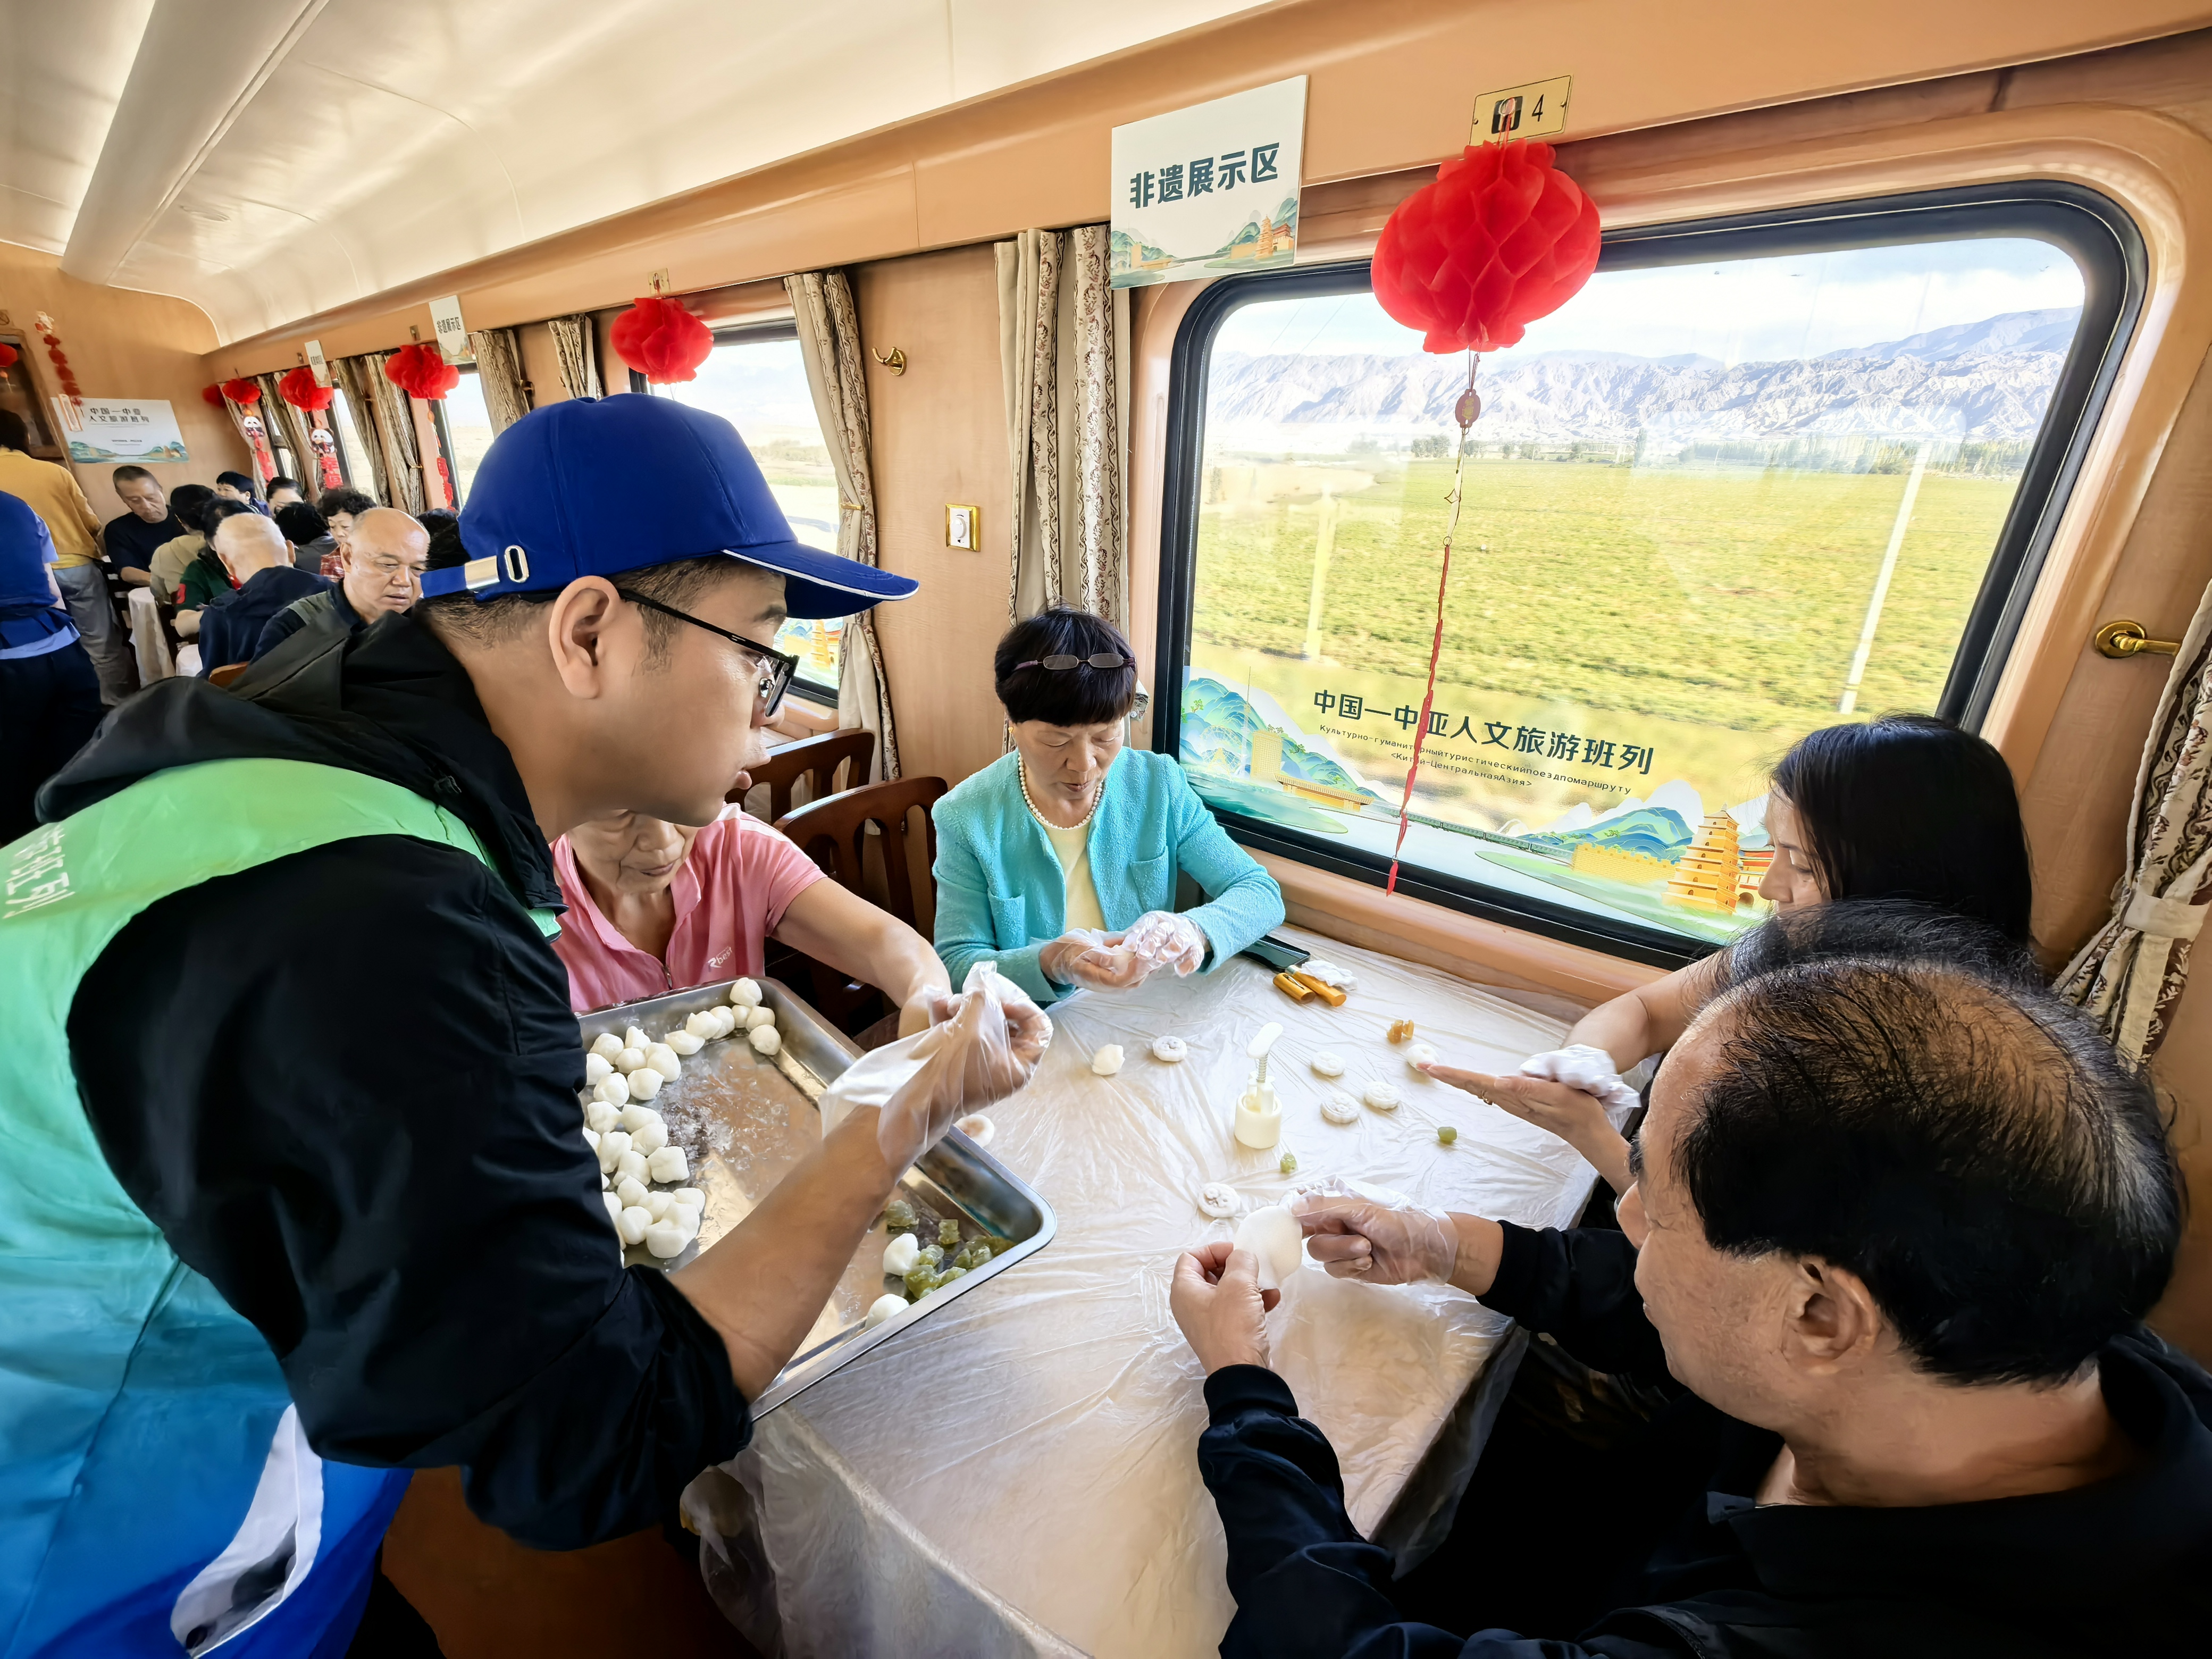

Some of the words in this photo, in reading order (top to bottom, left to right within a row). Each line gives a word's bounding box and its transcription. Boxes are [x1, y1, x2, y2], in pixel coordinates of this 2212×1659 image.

[1531, 93, 1544, 122] 4
[1130, 142, 1279, 209] 非遗展示区
